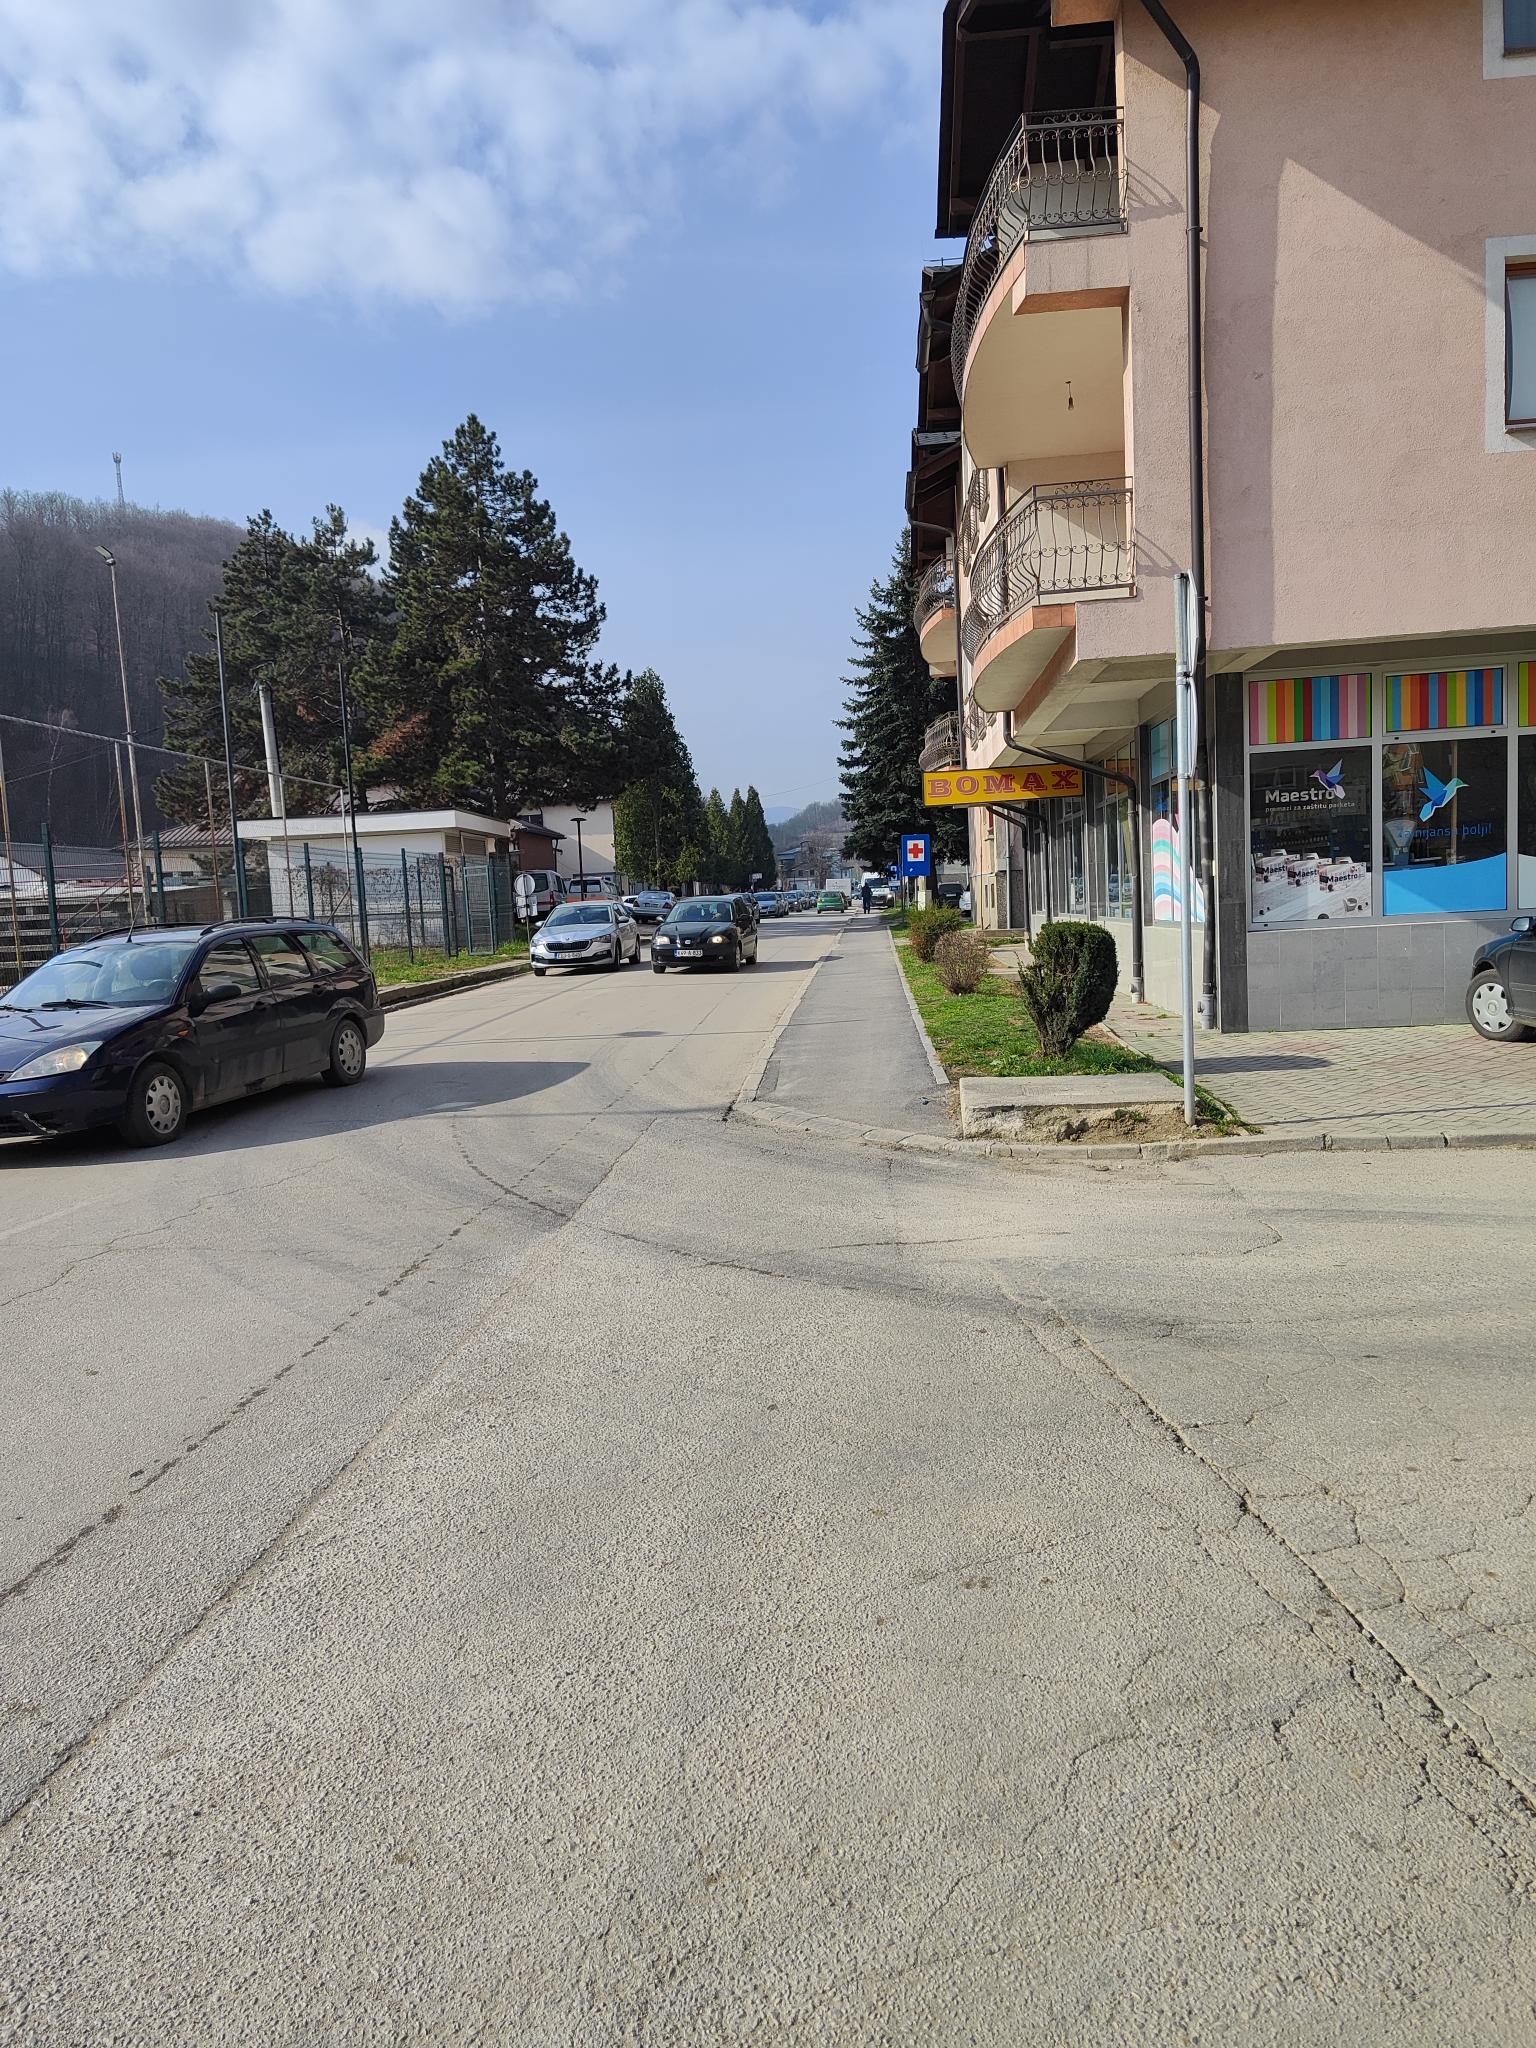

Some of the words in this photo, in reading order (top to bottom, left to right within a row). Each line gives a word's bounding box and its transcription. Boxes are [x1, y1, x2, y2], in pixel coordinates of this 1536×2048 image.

[928, 770, 1079, 798] BOMAX
[1265, 788, 1335, 803] Maestro
[1264, 865, 1288, 874] Maest
[1295, 868, 1320, 878] Maest
[1327, 873, 1358, 882] Maestro
